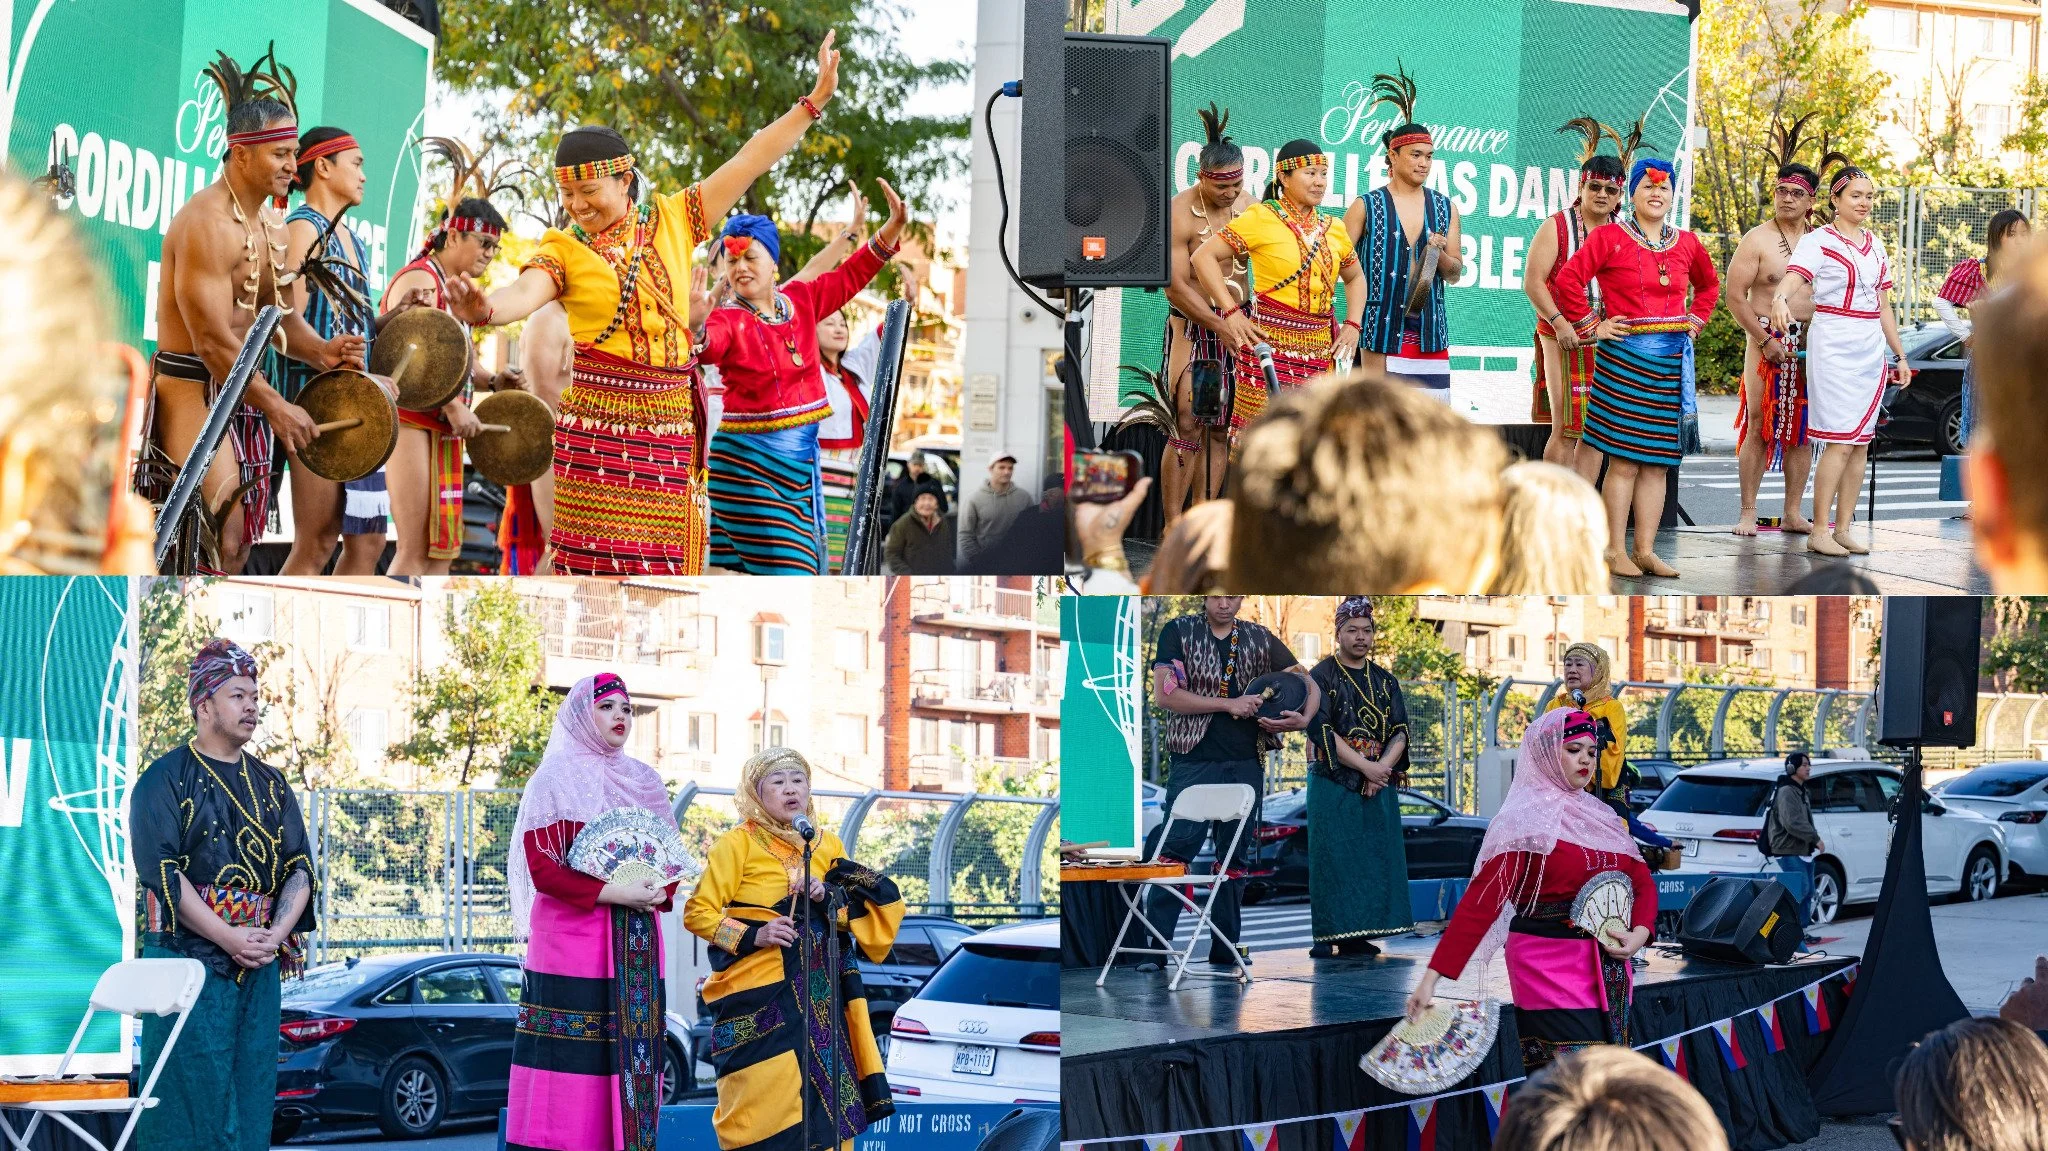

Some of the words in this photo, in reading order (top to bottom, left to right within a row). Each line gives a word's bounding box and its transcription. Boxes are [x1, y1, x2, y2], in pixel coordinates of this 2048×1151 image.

[1659, 881, 1685, 893] CROSS
[873, 1116, 891, 1134] DO
[899, 1113, 923, 1134] NOT
[931, 1113, 972, 1133] CROSS
